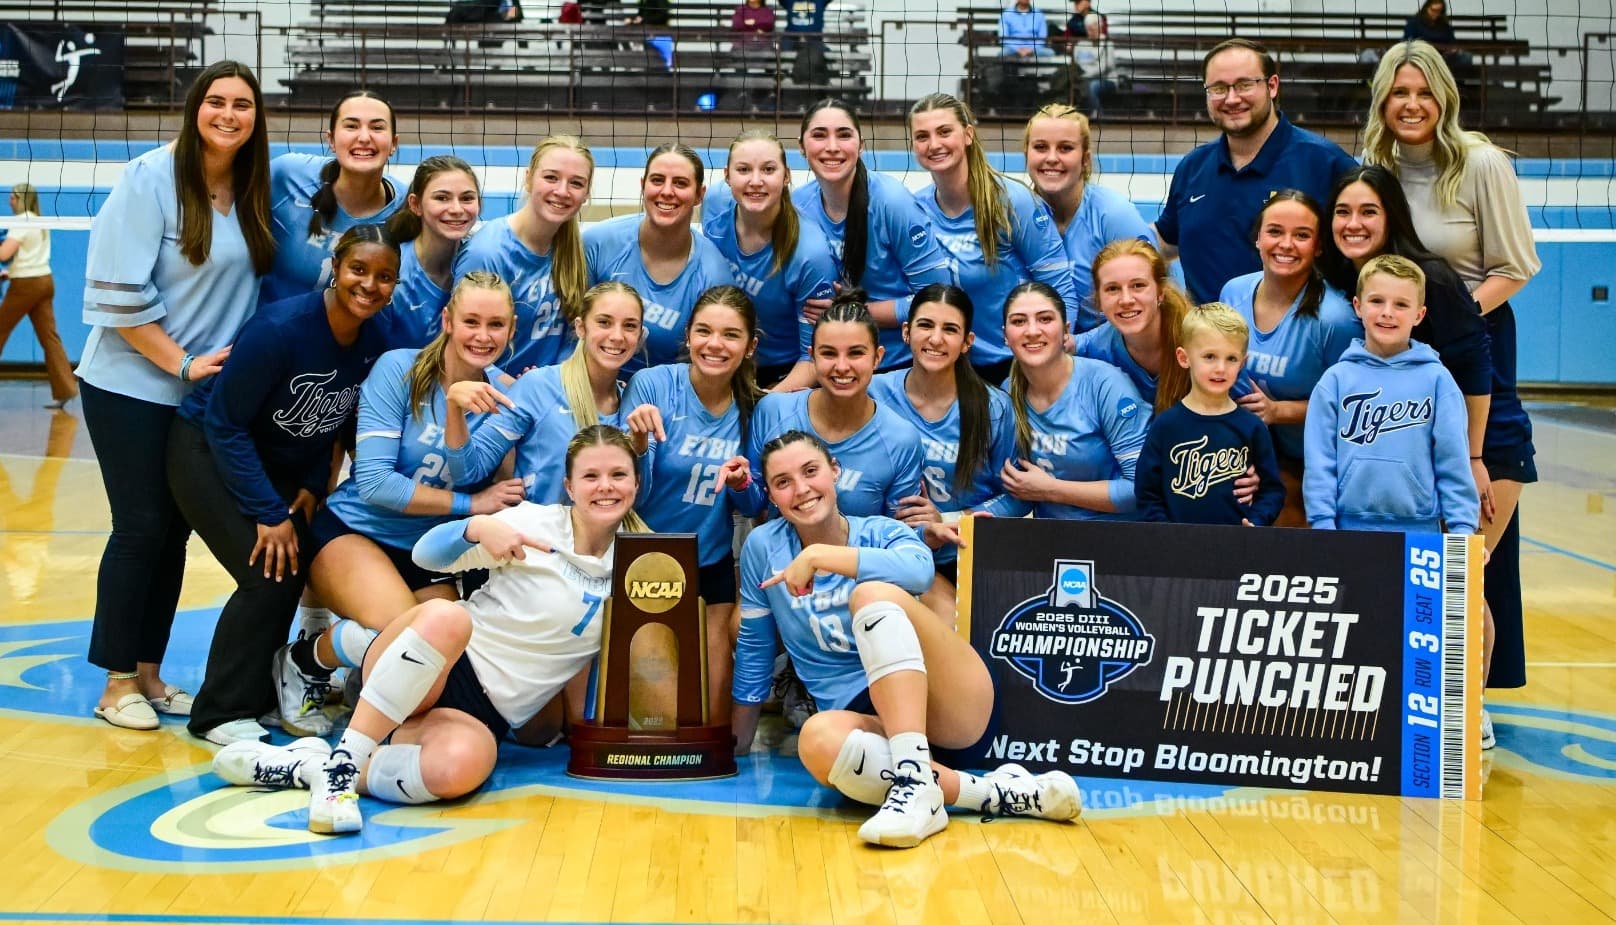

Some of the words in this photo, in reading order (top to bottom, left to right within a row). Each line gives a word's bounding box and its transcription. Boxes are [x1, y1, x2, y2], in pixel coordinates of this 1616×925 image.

[1246, 350, 1289, 378] TBU
[1339, 386, 1433, 447] Tigers
[678, 433, 740, 460] ETBU
[682, 462, 720, 507] 12
[1410, 546, 1441, 590] 25
[630, 580, 683, 600] NCAA
[1062, 580, 1087, 590] NCAA
[1236, 573, 1340, 605] 2025
[570, 591, 603, 638] 7
[1036, 612, 1075, 623] 2025
[1078, 615, 1110, 625] DIII
[1415, 593, 1433, 625] SEAT
[808, 613, 850, 652] 13
[1015, 621, 1066, 633] WOMEN'S
[1067, 624, 1131, 636] VOLLEYBALL
[1197, 606, 1360, 659] TICKET
[1408, 630, 1440, 654] 3
[996, 633, 1149, 660] CHAMPIONSHIP
[1159, 656, 1388, 713] PUNCHED
[1414, 657, 1433, 688] ROW
[1407, 692, 1439, 729] 12
[606, 753, 651, 766] REGIONAL
[653, 754, 703, 766] CHAMPION
[984, 734, 1059, 763] Next
[1066, 738, 1146, 773] Stop
[1153, 743, 1383, 785] Bloomington!
[1412, 733, 1432, 789] SECTION
